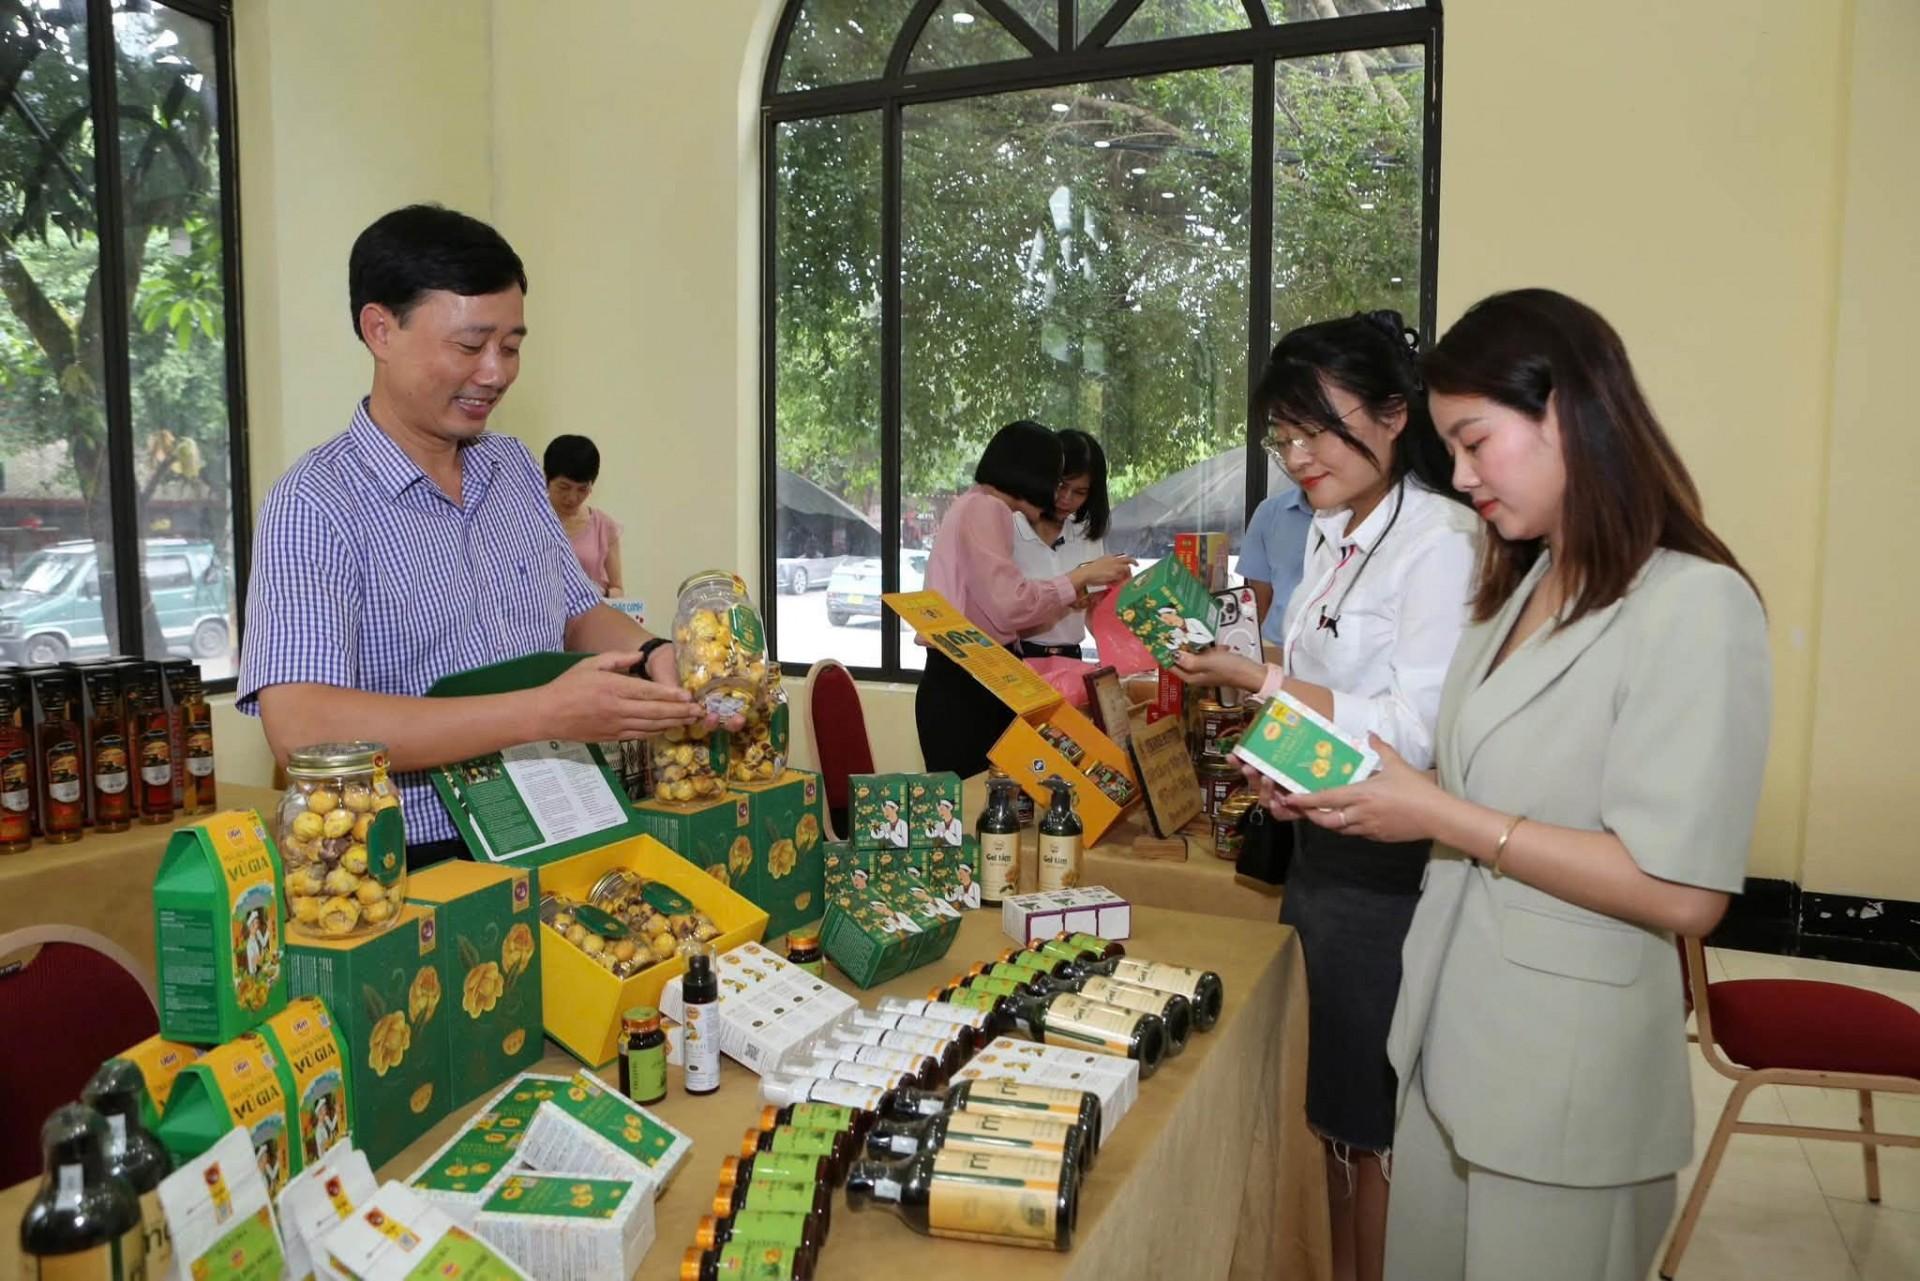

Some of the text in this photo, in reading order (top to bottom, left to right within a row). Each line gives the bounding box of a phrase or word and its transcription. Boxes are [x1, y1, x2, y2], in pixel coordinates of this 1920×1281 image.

[248, 856, 270, 873] GIA
[314, 1042, 337, 1063] GIA
[256, 1085, 280, 1106] GIA
